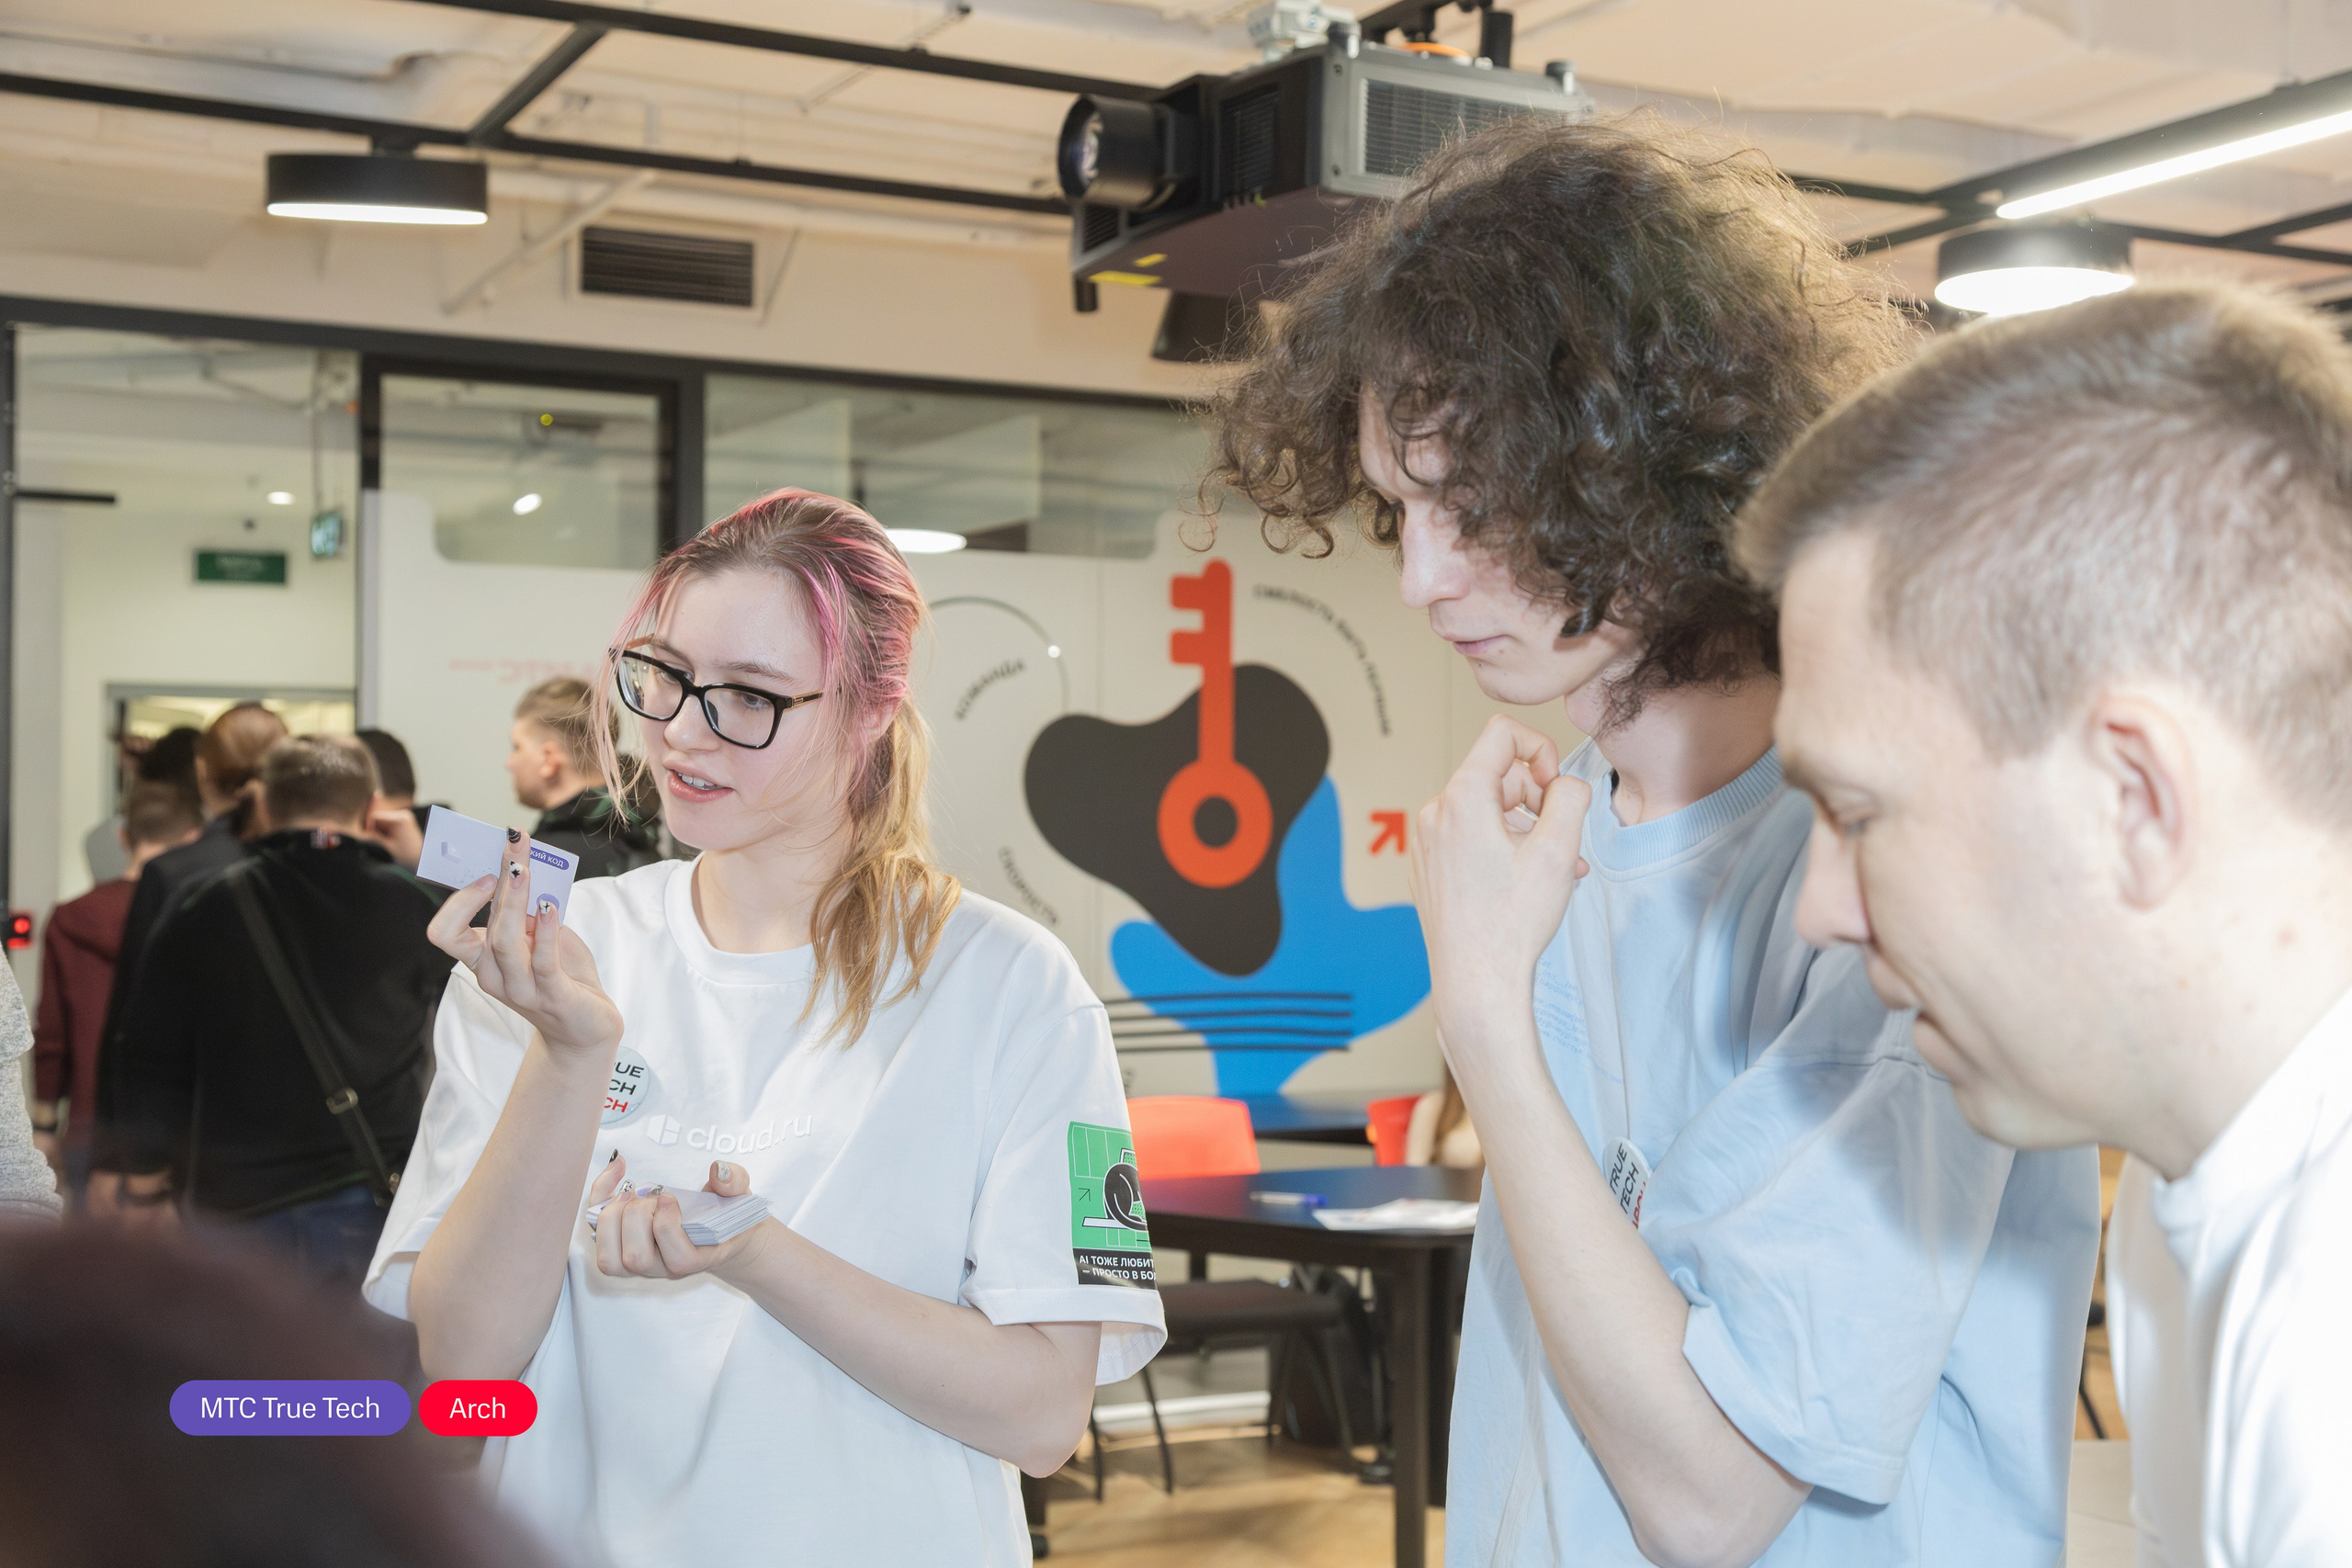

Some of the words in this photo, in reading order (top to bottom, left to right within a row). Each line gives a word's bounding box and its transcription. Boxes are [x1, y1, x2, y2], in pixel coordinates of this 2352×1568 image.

[614, 1062, 644, 1078] UE
[609, 1078, 637, 1096] CH
[604, 1097, 628, 1113] CH
[686, 1114, 814, 1155] cloud.ru
[1610, 1143, 1628, 1195] TRUE
[1620, 1162, 1640, 1214] TECH
[1091, 1256, 1119, 1267] ТОЖЕ
[1091, 1267, 1130, 1280] ПРОСТО
[1131, 1270, 1139, 1280] В
